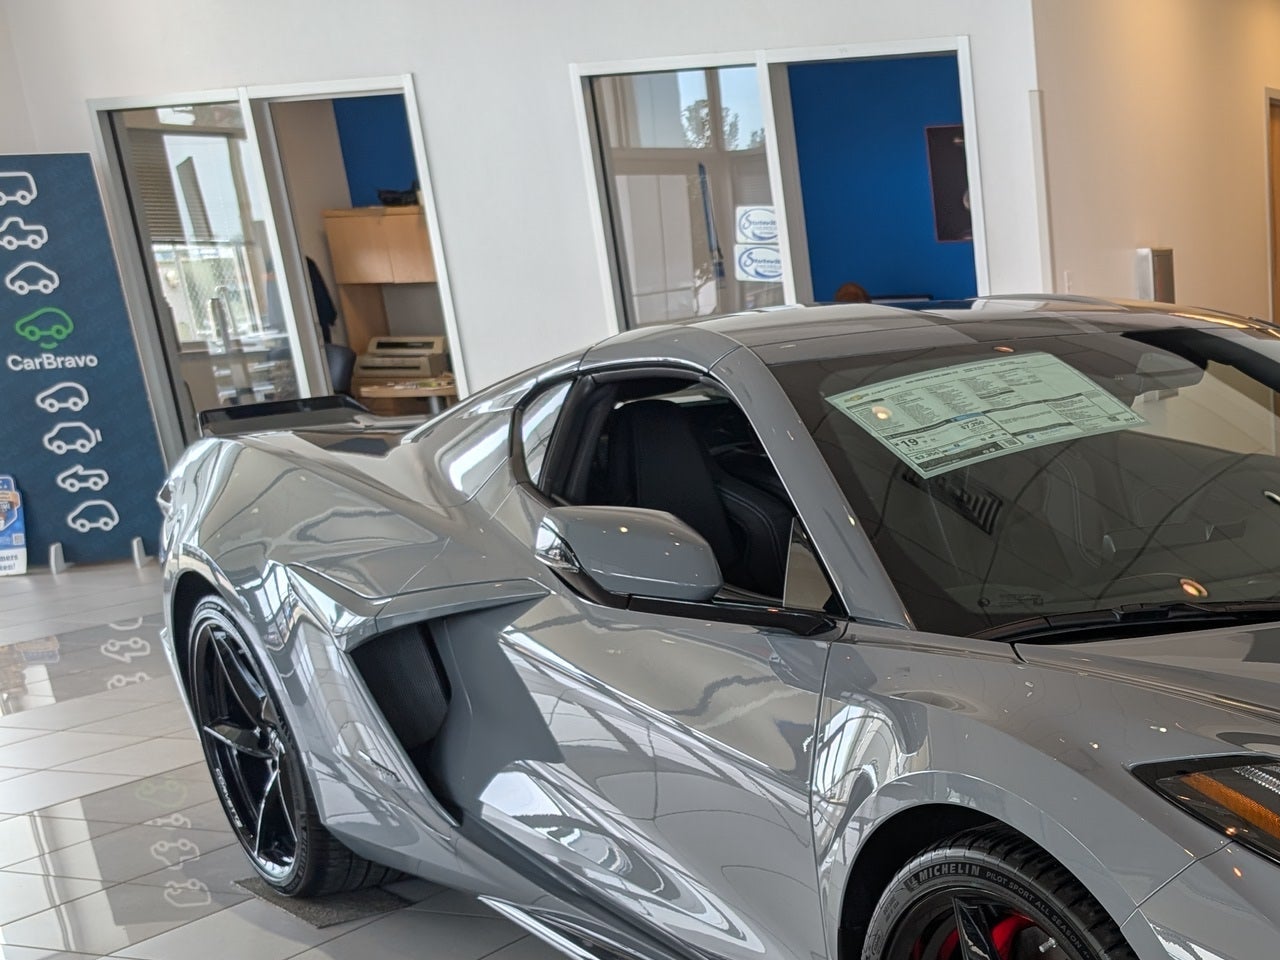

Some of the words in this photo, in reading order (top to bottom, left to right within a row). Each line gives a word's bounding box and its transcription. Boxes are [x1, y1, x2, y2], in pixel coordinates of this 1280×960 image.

[7, 354, 98, 371] CarBravo
[900, 438, 919, 448] 19
[919, 863, 980, 881] MICHELIN
[986, 871, 1008, 884] PILOT
[1008, 882, 1035, 900] SPORT
[1034, 901, 1051, 916] ALL
[1051, 914, 1082, 949] SEASON
